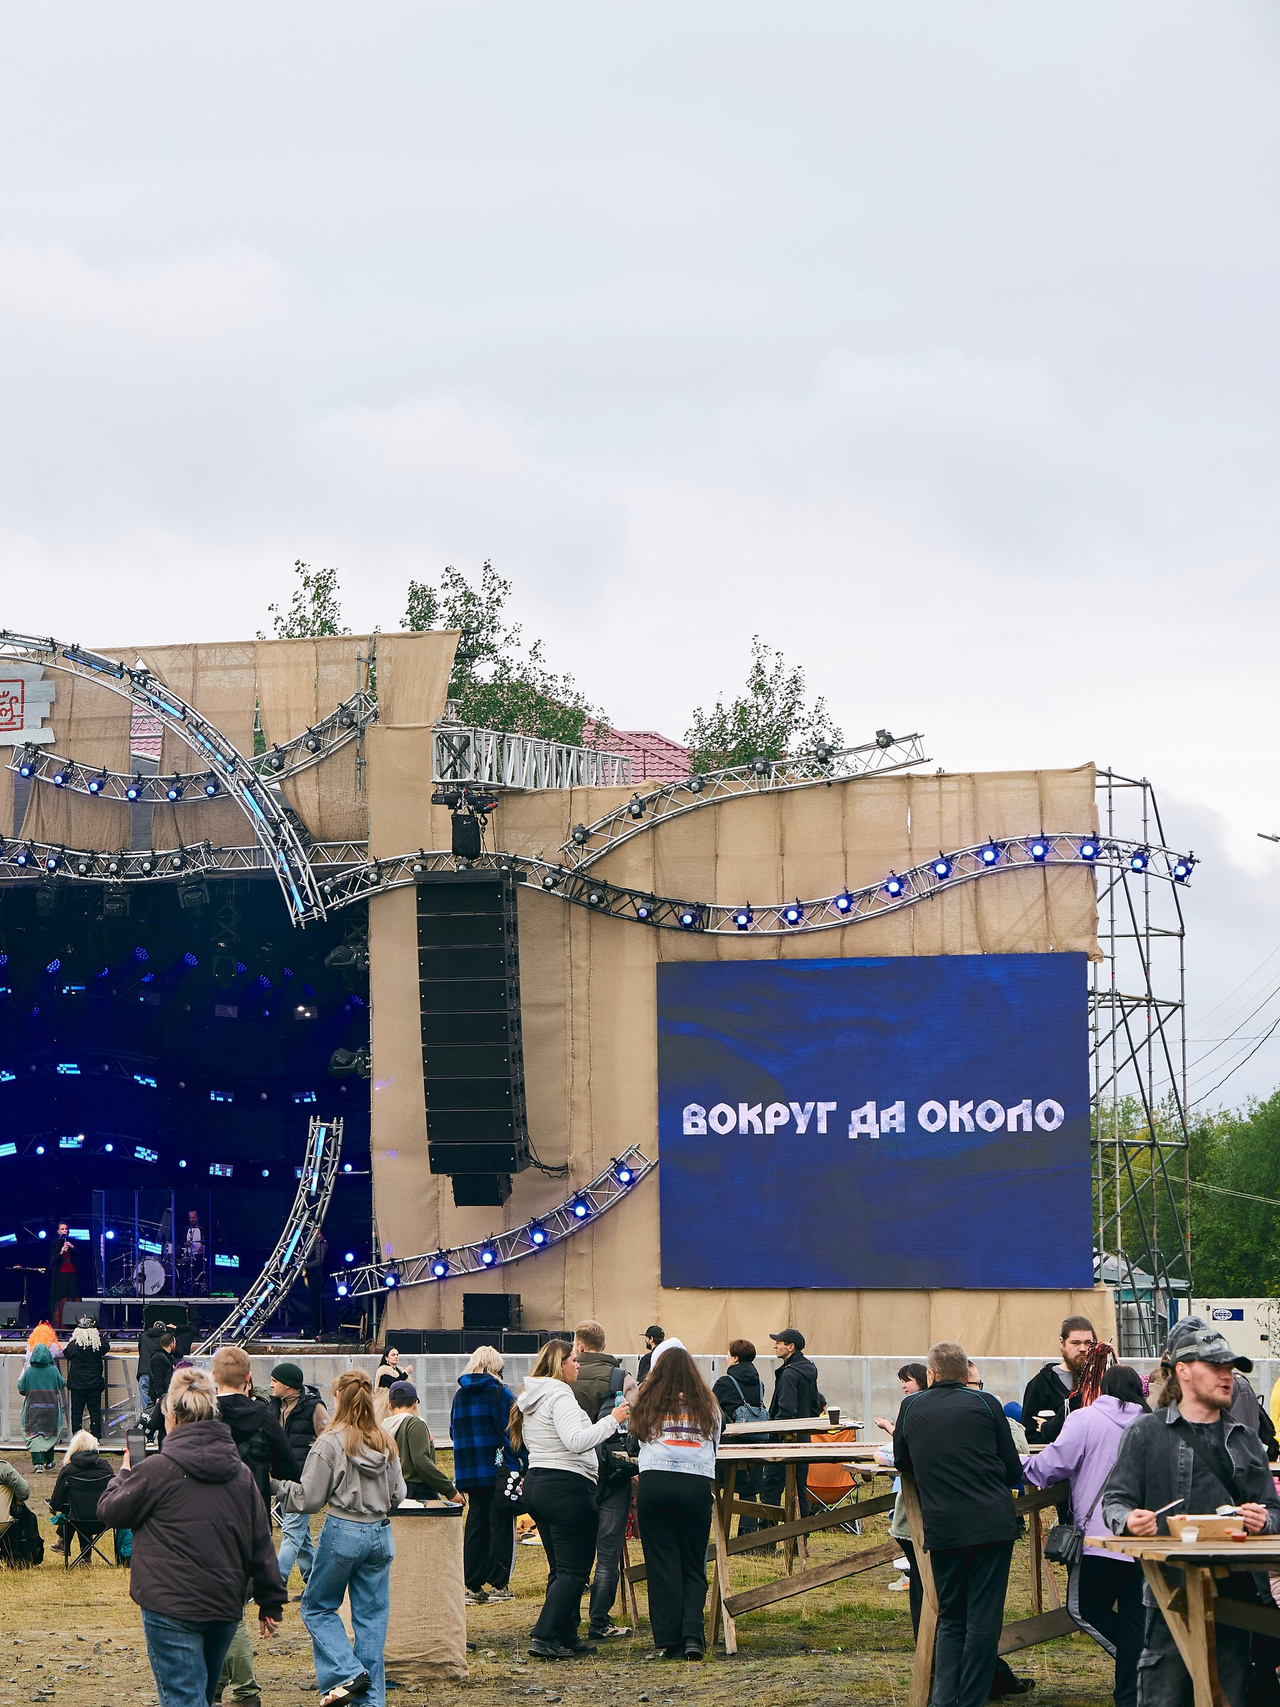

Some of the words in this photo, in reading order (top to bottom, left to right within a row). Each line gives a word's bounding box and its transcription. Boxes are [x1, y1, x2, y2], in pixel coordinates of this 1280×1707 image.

[682, 1102, 837, 1135] ВОКРУГ
[848, 1101, 906, 1139] ДА
[918, 1099, 1065, 1132] ОКОЛО
